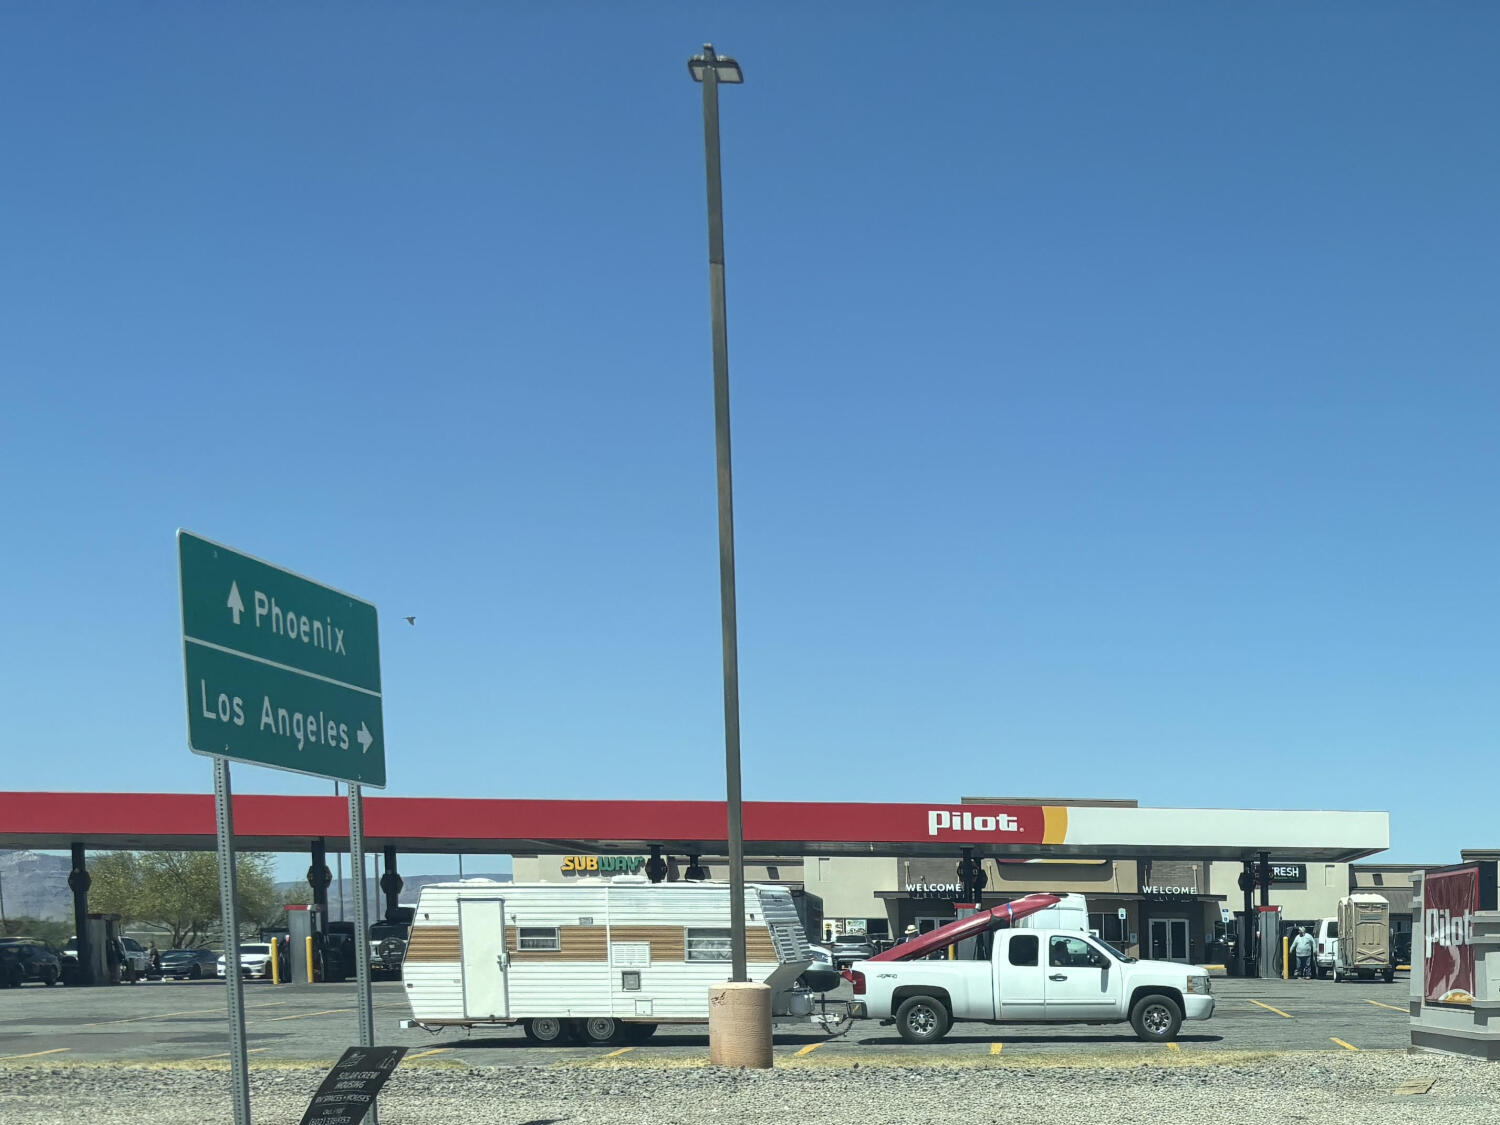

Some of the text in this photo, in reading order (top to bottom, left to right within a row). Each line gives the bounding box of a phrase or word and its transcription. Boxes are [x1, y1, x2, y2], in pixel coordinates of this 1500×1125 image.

[254, 590, 346, 656] Phoenix
[201, 679, 349, 751] Los Angeles
[928, 810, 1018, 836] Pilot
[561, 856, 645, 872] SUBWAY
[1272, 866, 1299, 878] RESH
[905, 883, 962, 892] WELCOME
[1142, 885, 1197, 894] WELCOME
[1425, 908, 1473, 959] Pilot
